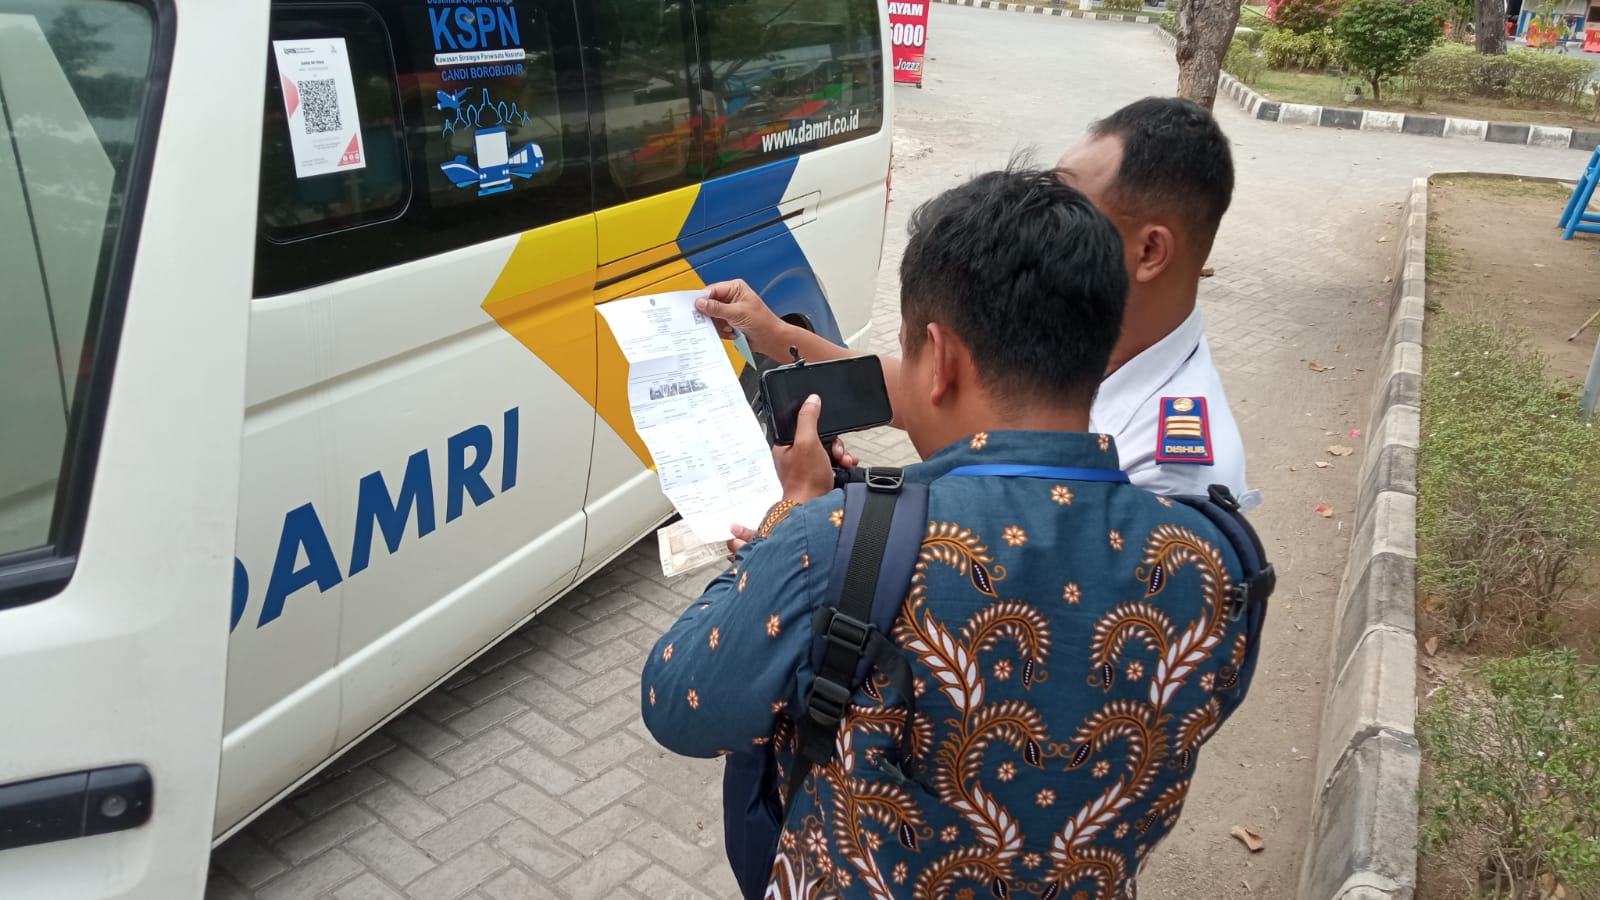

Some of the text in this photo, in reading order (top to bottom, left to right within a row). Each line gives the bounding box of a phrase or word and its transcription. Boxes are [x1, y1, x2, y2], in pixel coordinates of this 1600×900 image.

[889, 2, 924, 16] AYAM
[429, 7, 520, 50] KSPN
[442, 64, 523, 80] CANDI BOROBUDUR
[762, 109, 859, 152] www.damri.co.id
[1165, 445, 1205, 454] DISHUB
